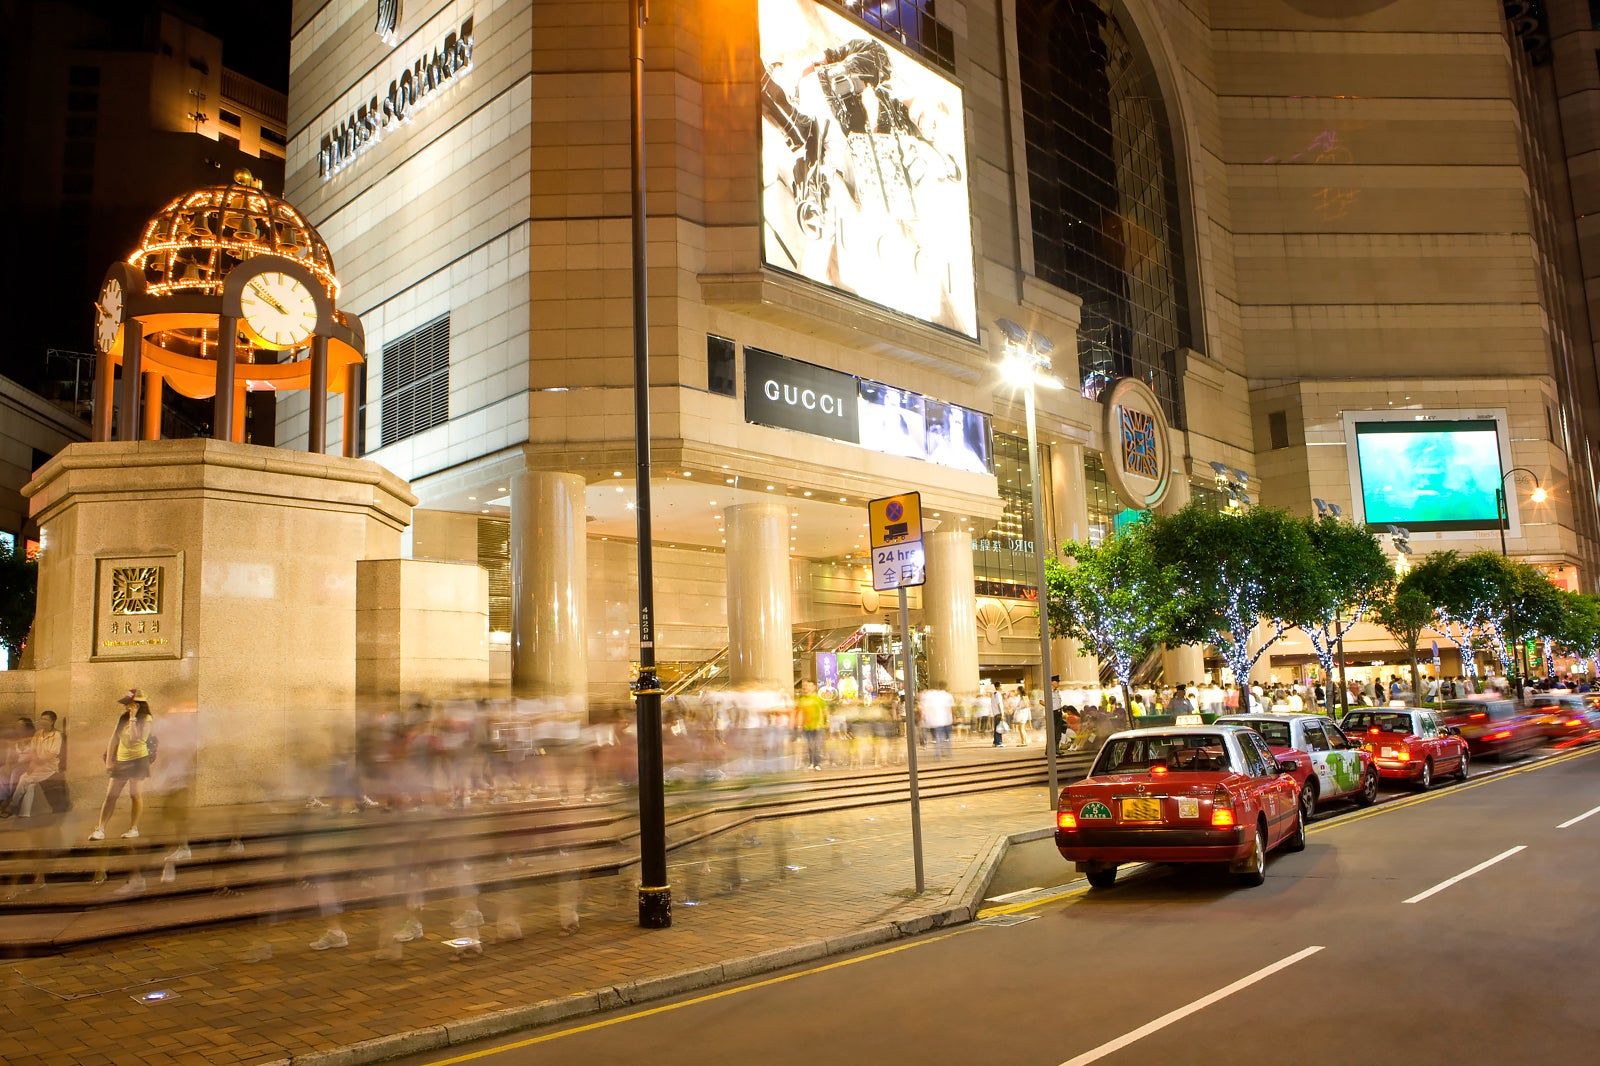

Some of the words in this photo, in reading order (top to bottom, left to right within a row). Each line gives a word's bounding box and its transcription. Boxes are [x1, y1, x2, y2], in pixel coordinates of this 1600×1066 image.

[317, 96, 381, 178] TIMES
[383, 19, 474, 128] SQUARE
[764, 380, 843, 417] GUCCI
[878, 551, 894, 564] 24
[883, 564, 914, 584] 全日
